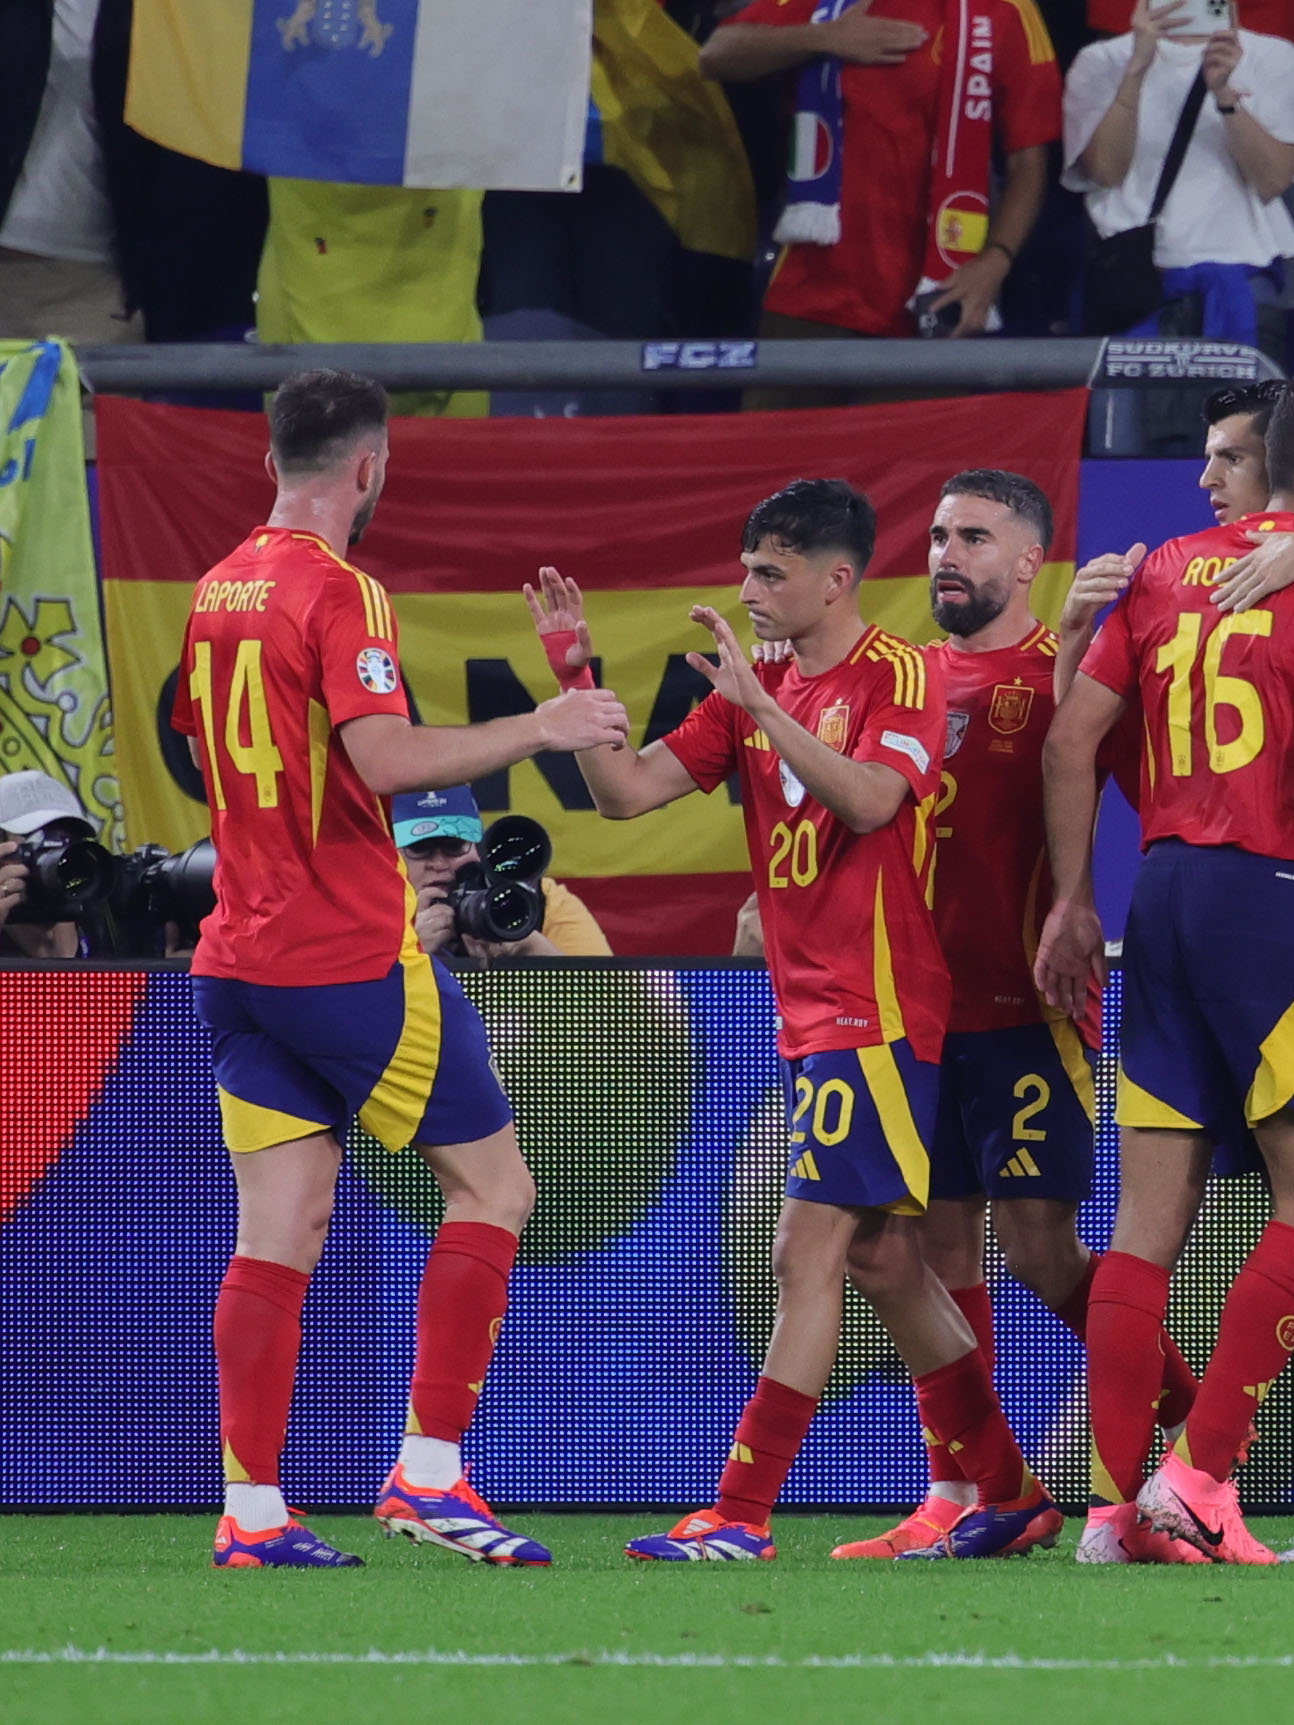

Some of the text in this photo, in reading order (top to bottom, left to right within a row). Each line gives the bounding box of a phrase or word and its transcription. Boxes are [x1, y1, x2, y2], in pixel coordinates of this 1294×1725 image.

[965, 15, 993, 122] SPAIN
[643, 341, 755, 370] FCZ
[195, 580, 276, 612] LAPORTE
[190, 640, 284, 811] 14
[1156, 608, 1273, 777] 16
[769, 819, 818, 888] 20
[790, 1076, 855, 1147] 20
[1012, 1073, 1050, 1142] 2
